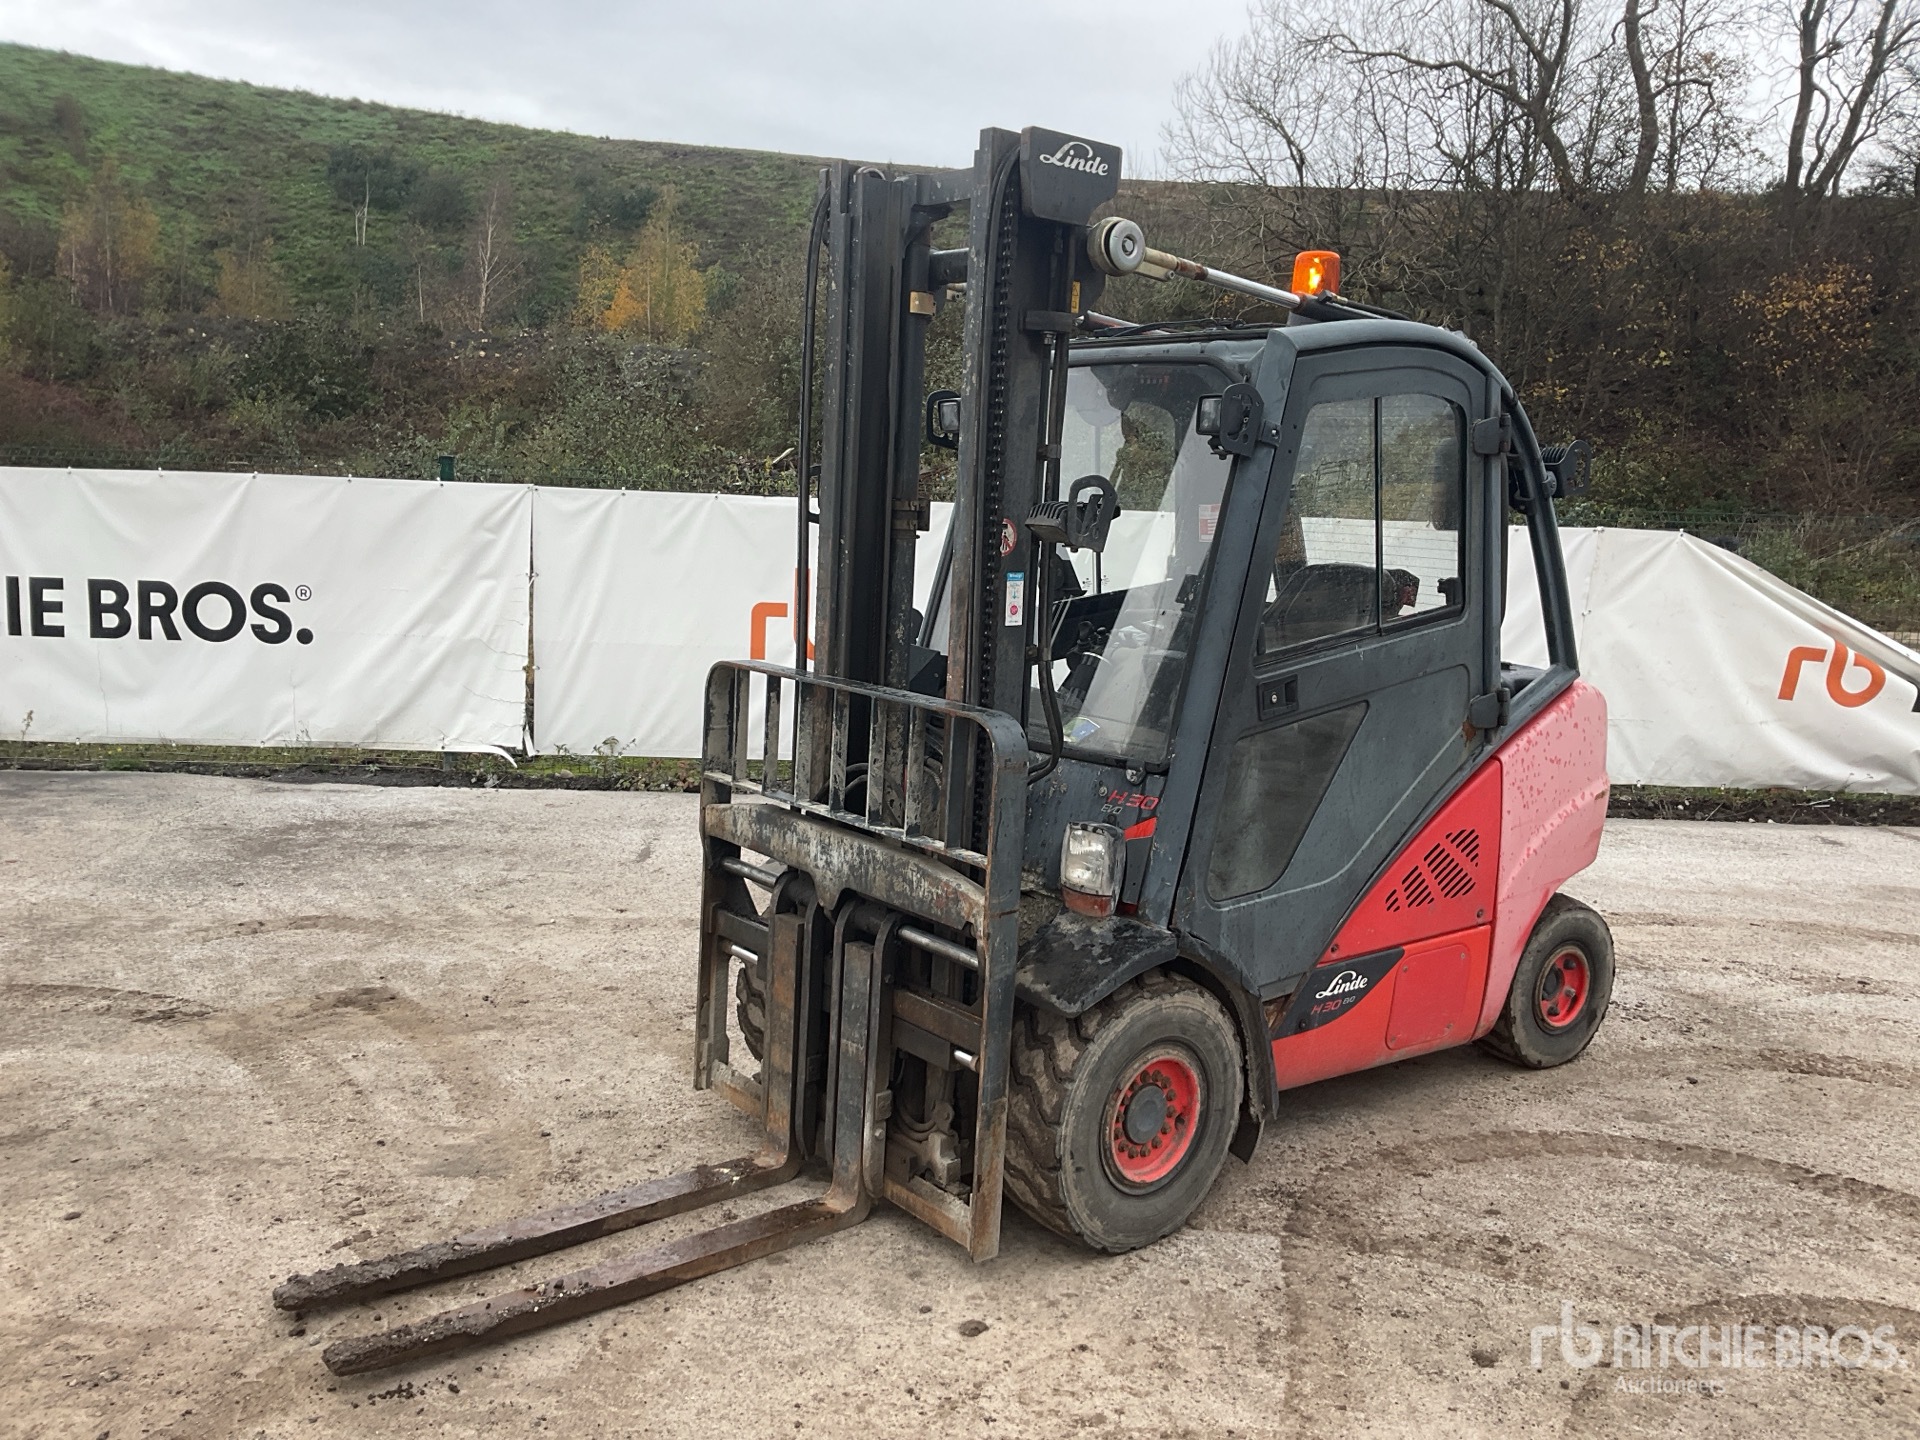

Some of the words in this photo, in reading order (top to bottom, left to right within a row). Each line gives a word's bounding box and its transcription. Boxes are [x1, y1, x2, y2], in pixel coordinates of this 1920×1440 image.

[1040, 142, 1109, 176] Linde
[1101, 804, 1123, 814] EVO
[1316, 970, 1368, 999] Linde
